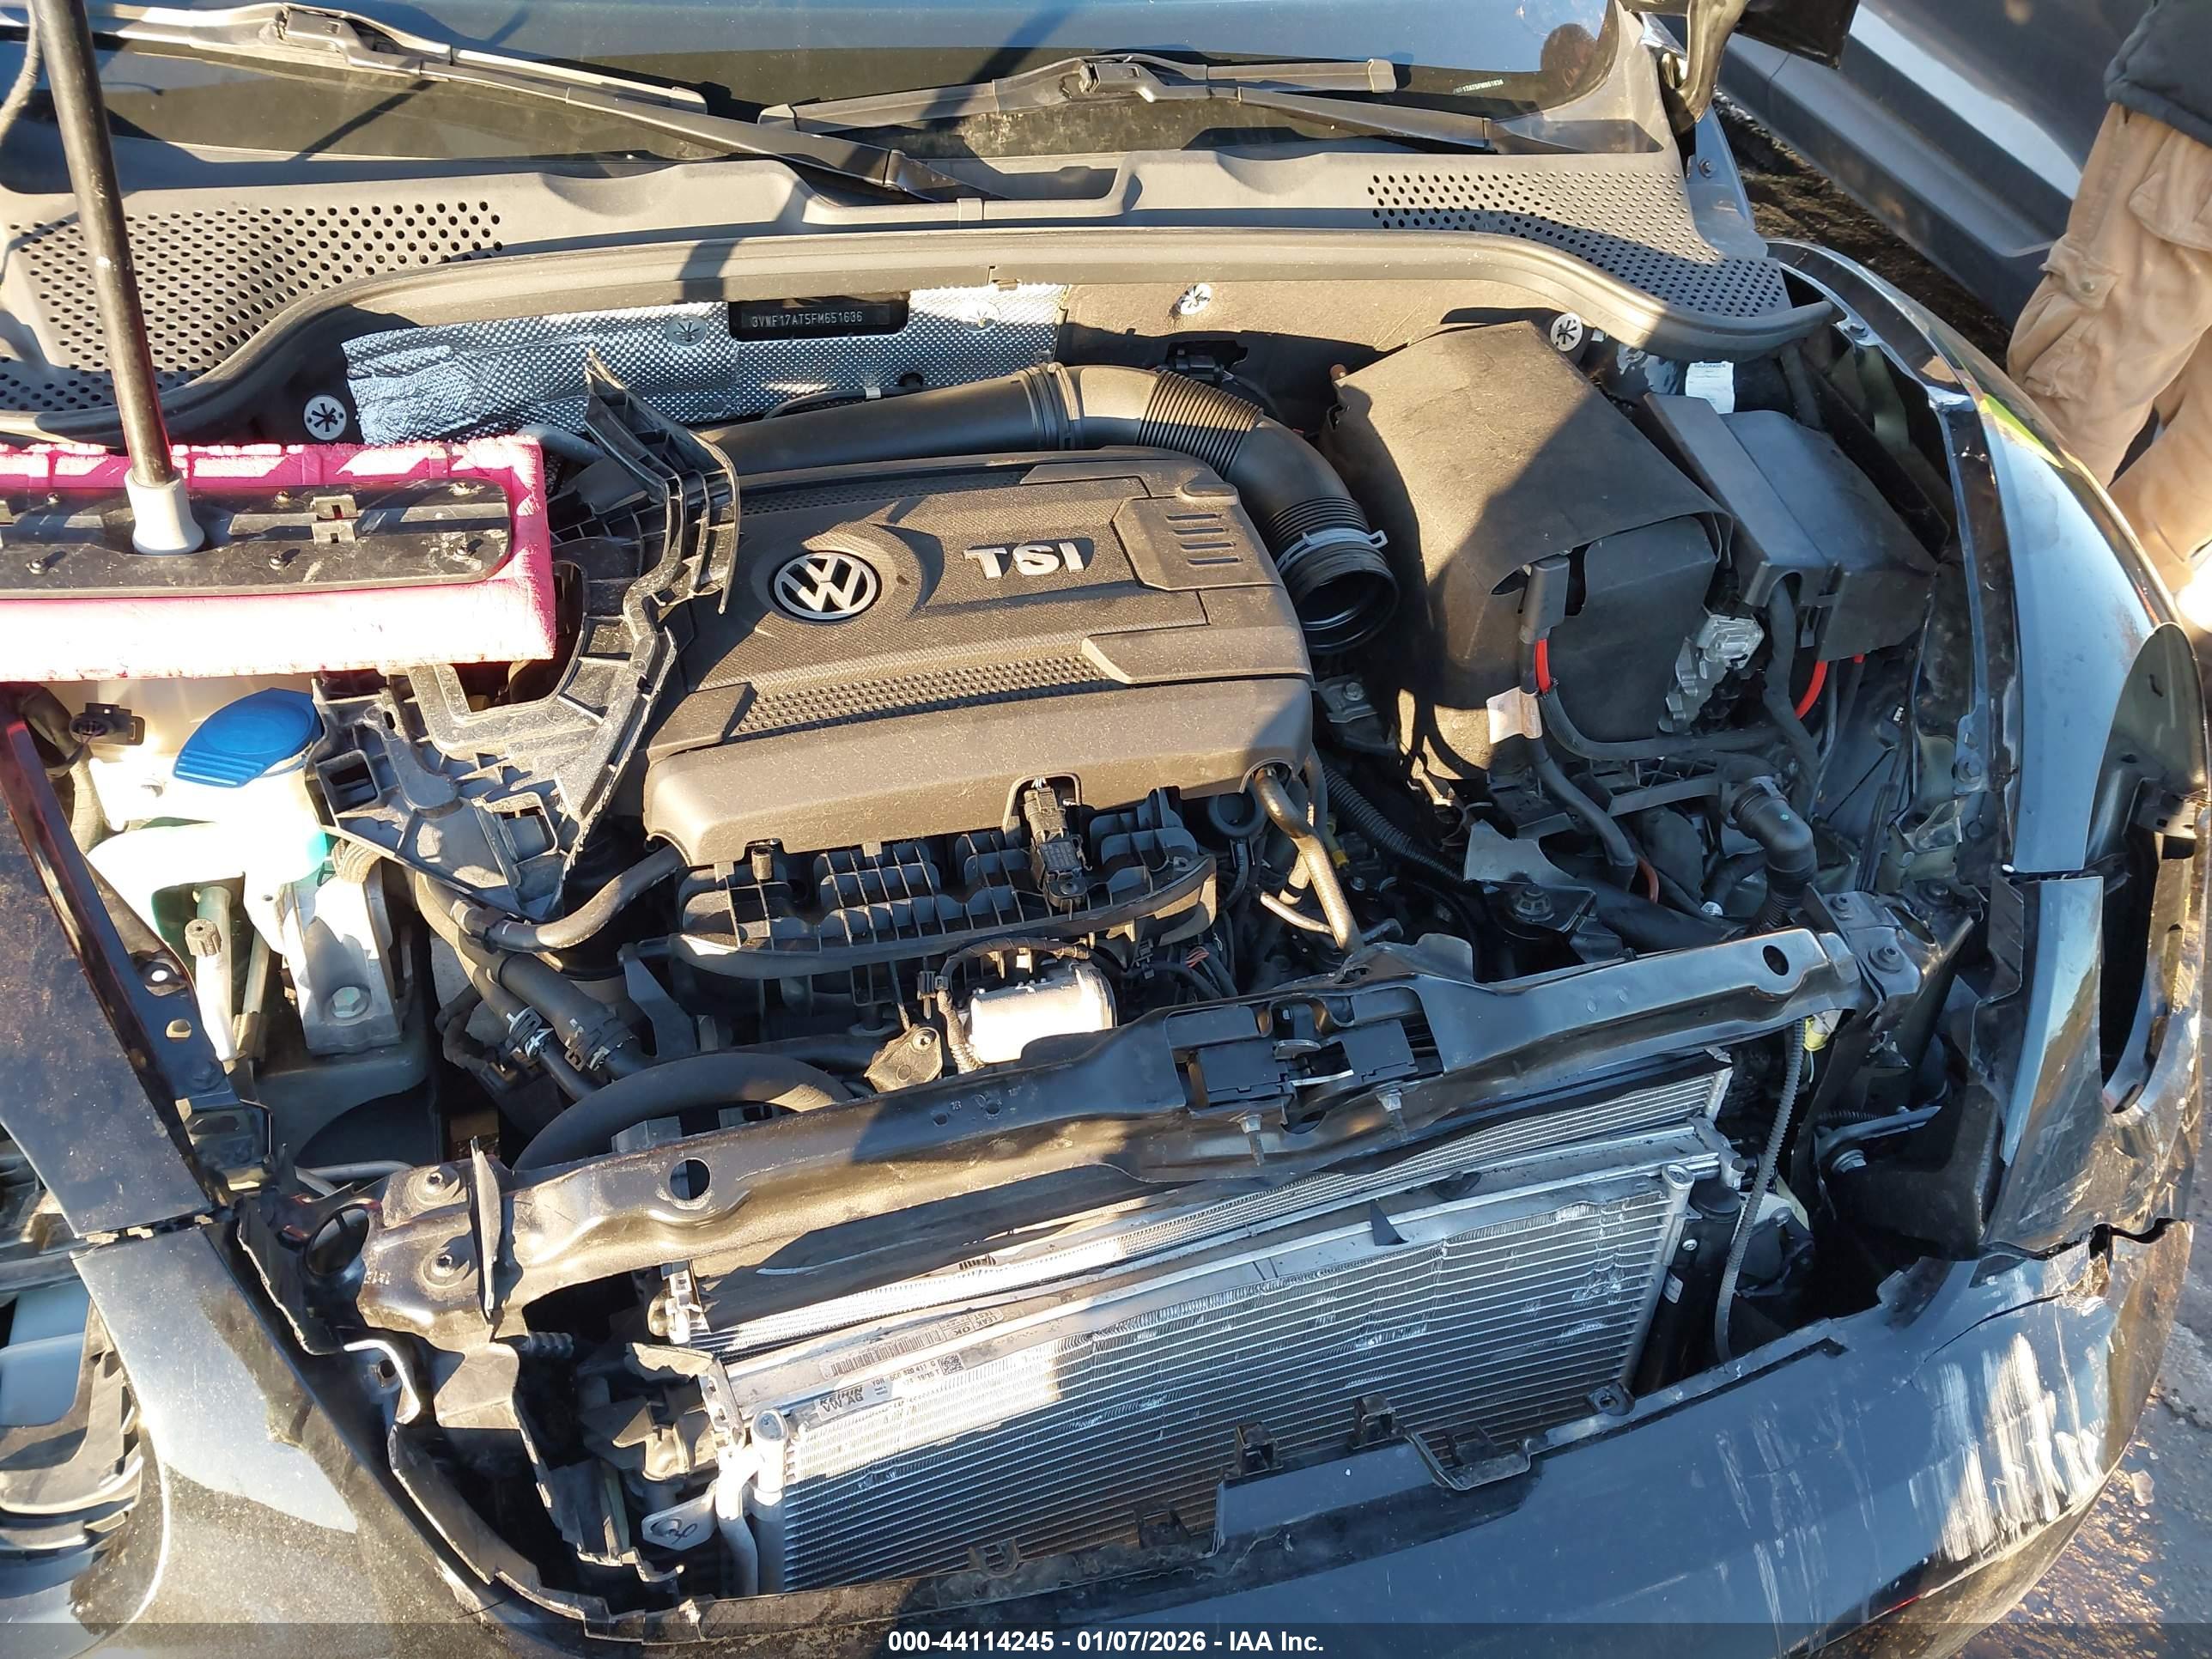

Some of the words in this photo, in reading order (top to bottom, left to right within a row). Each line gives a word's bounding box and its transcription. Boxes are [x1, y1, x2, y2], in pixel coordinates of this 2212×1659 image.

[751, 311, 863, 328] 3VWF17AT5FM651636
[963, 541, 1085, 580] TSI
[775, 551, 877, 619] VW
[953, 1327, 971, 1336] OK
[819, 1387, 863, 1406] KEIHIN
[822, 1399, 842, 1412] VW
[848, 1393, 864, 1405] AG
